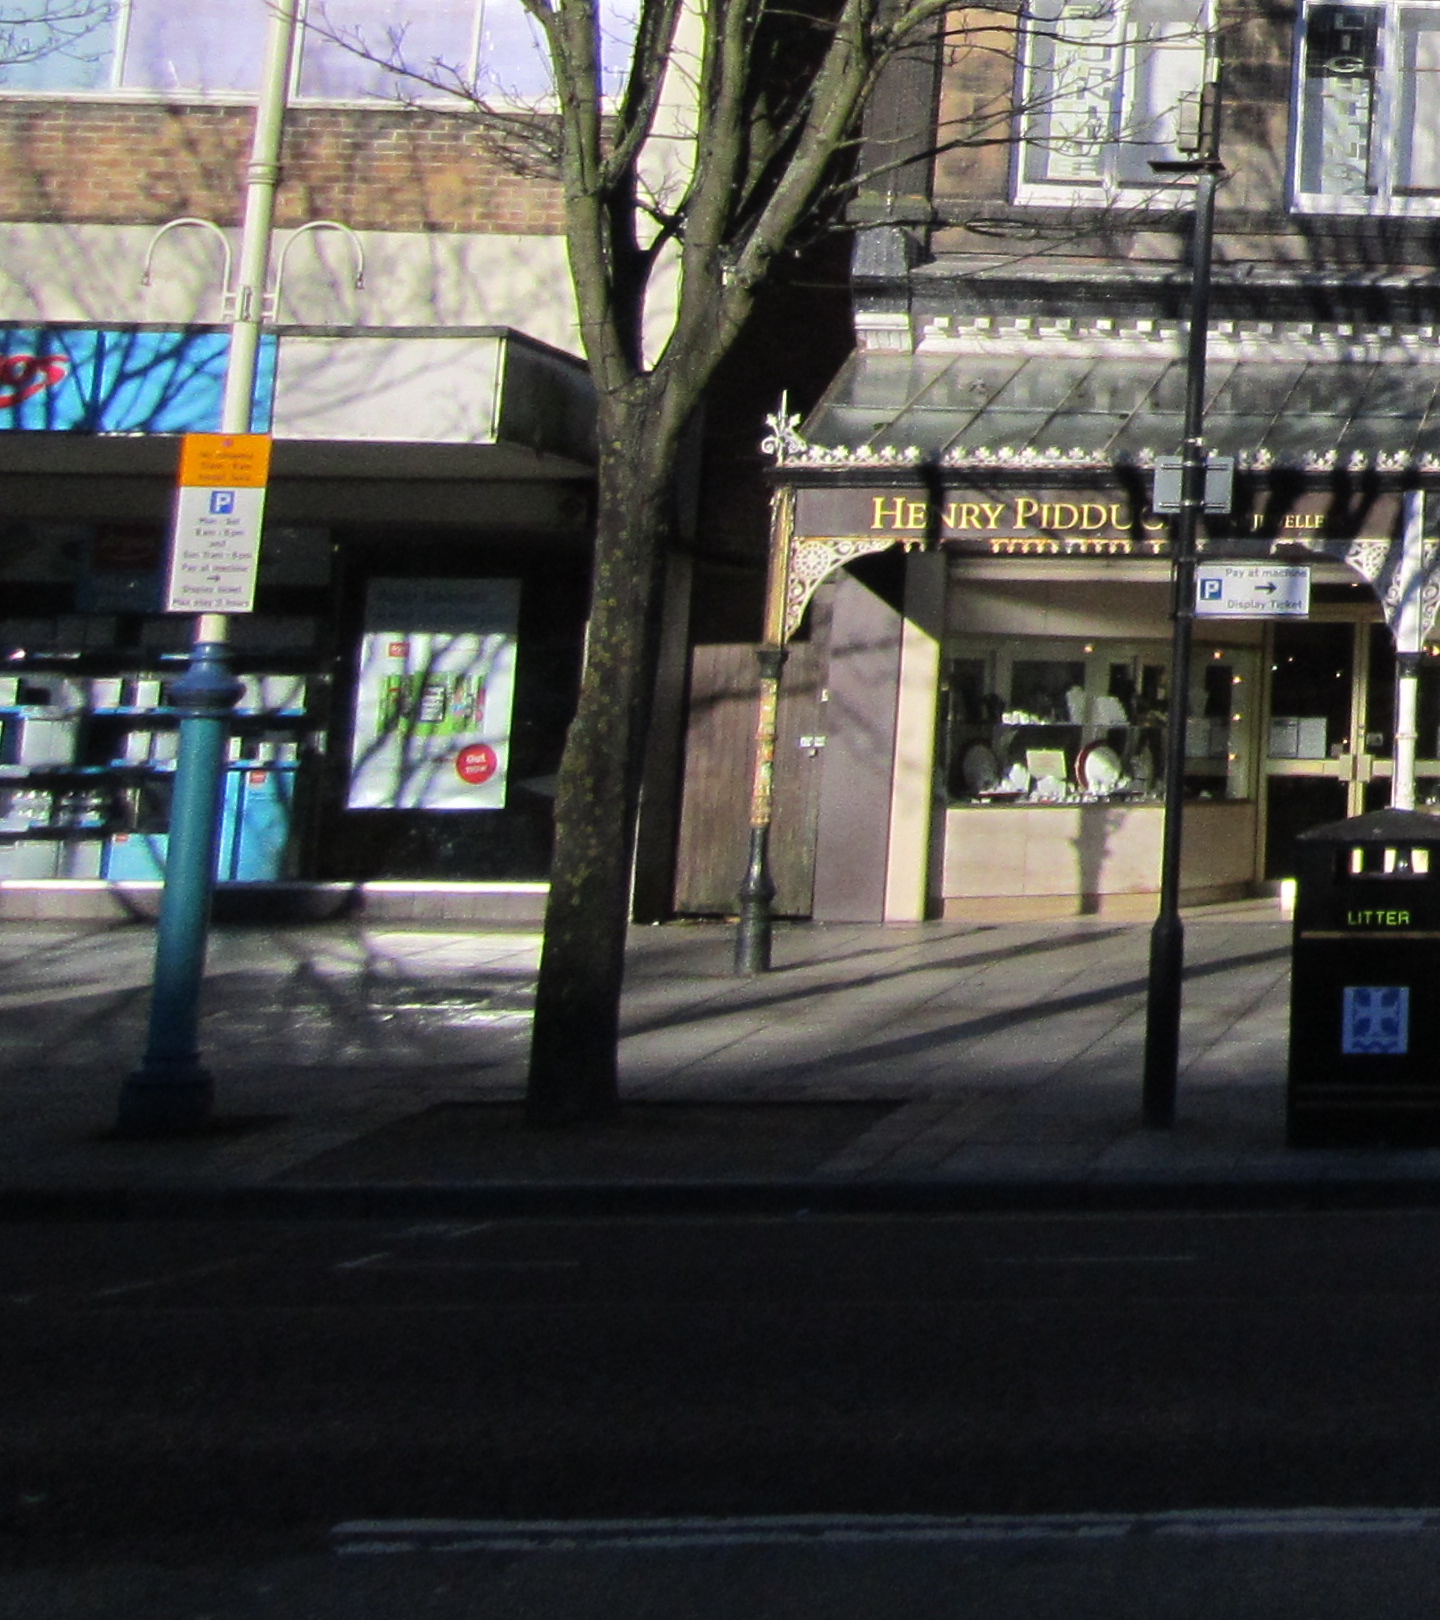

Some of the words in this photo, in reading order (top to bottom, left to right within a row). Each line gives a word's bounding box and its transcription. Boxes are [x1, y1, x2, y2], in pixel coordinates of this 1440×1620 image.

[870, 496, 1006, 530] HENRY
[1013, 497, 1168, 531] PIDDUC
[1225, 568, 1247, 579] Pay
[1249, 568, 1261, 577] at
[1263, 567, 1307, 578] machine
[1227, 599, 1266, 611] Display
[1269, 599, 1302, 610] Ticket
[1347, 910, 1410, 926] LITTER
